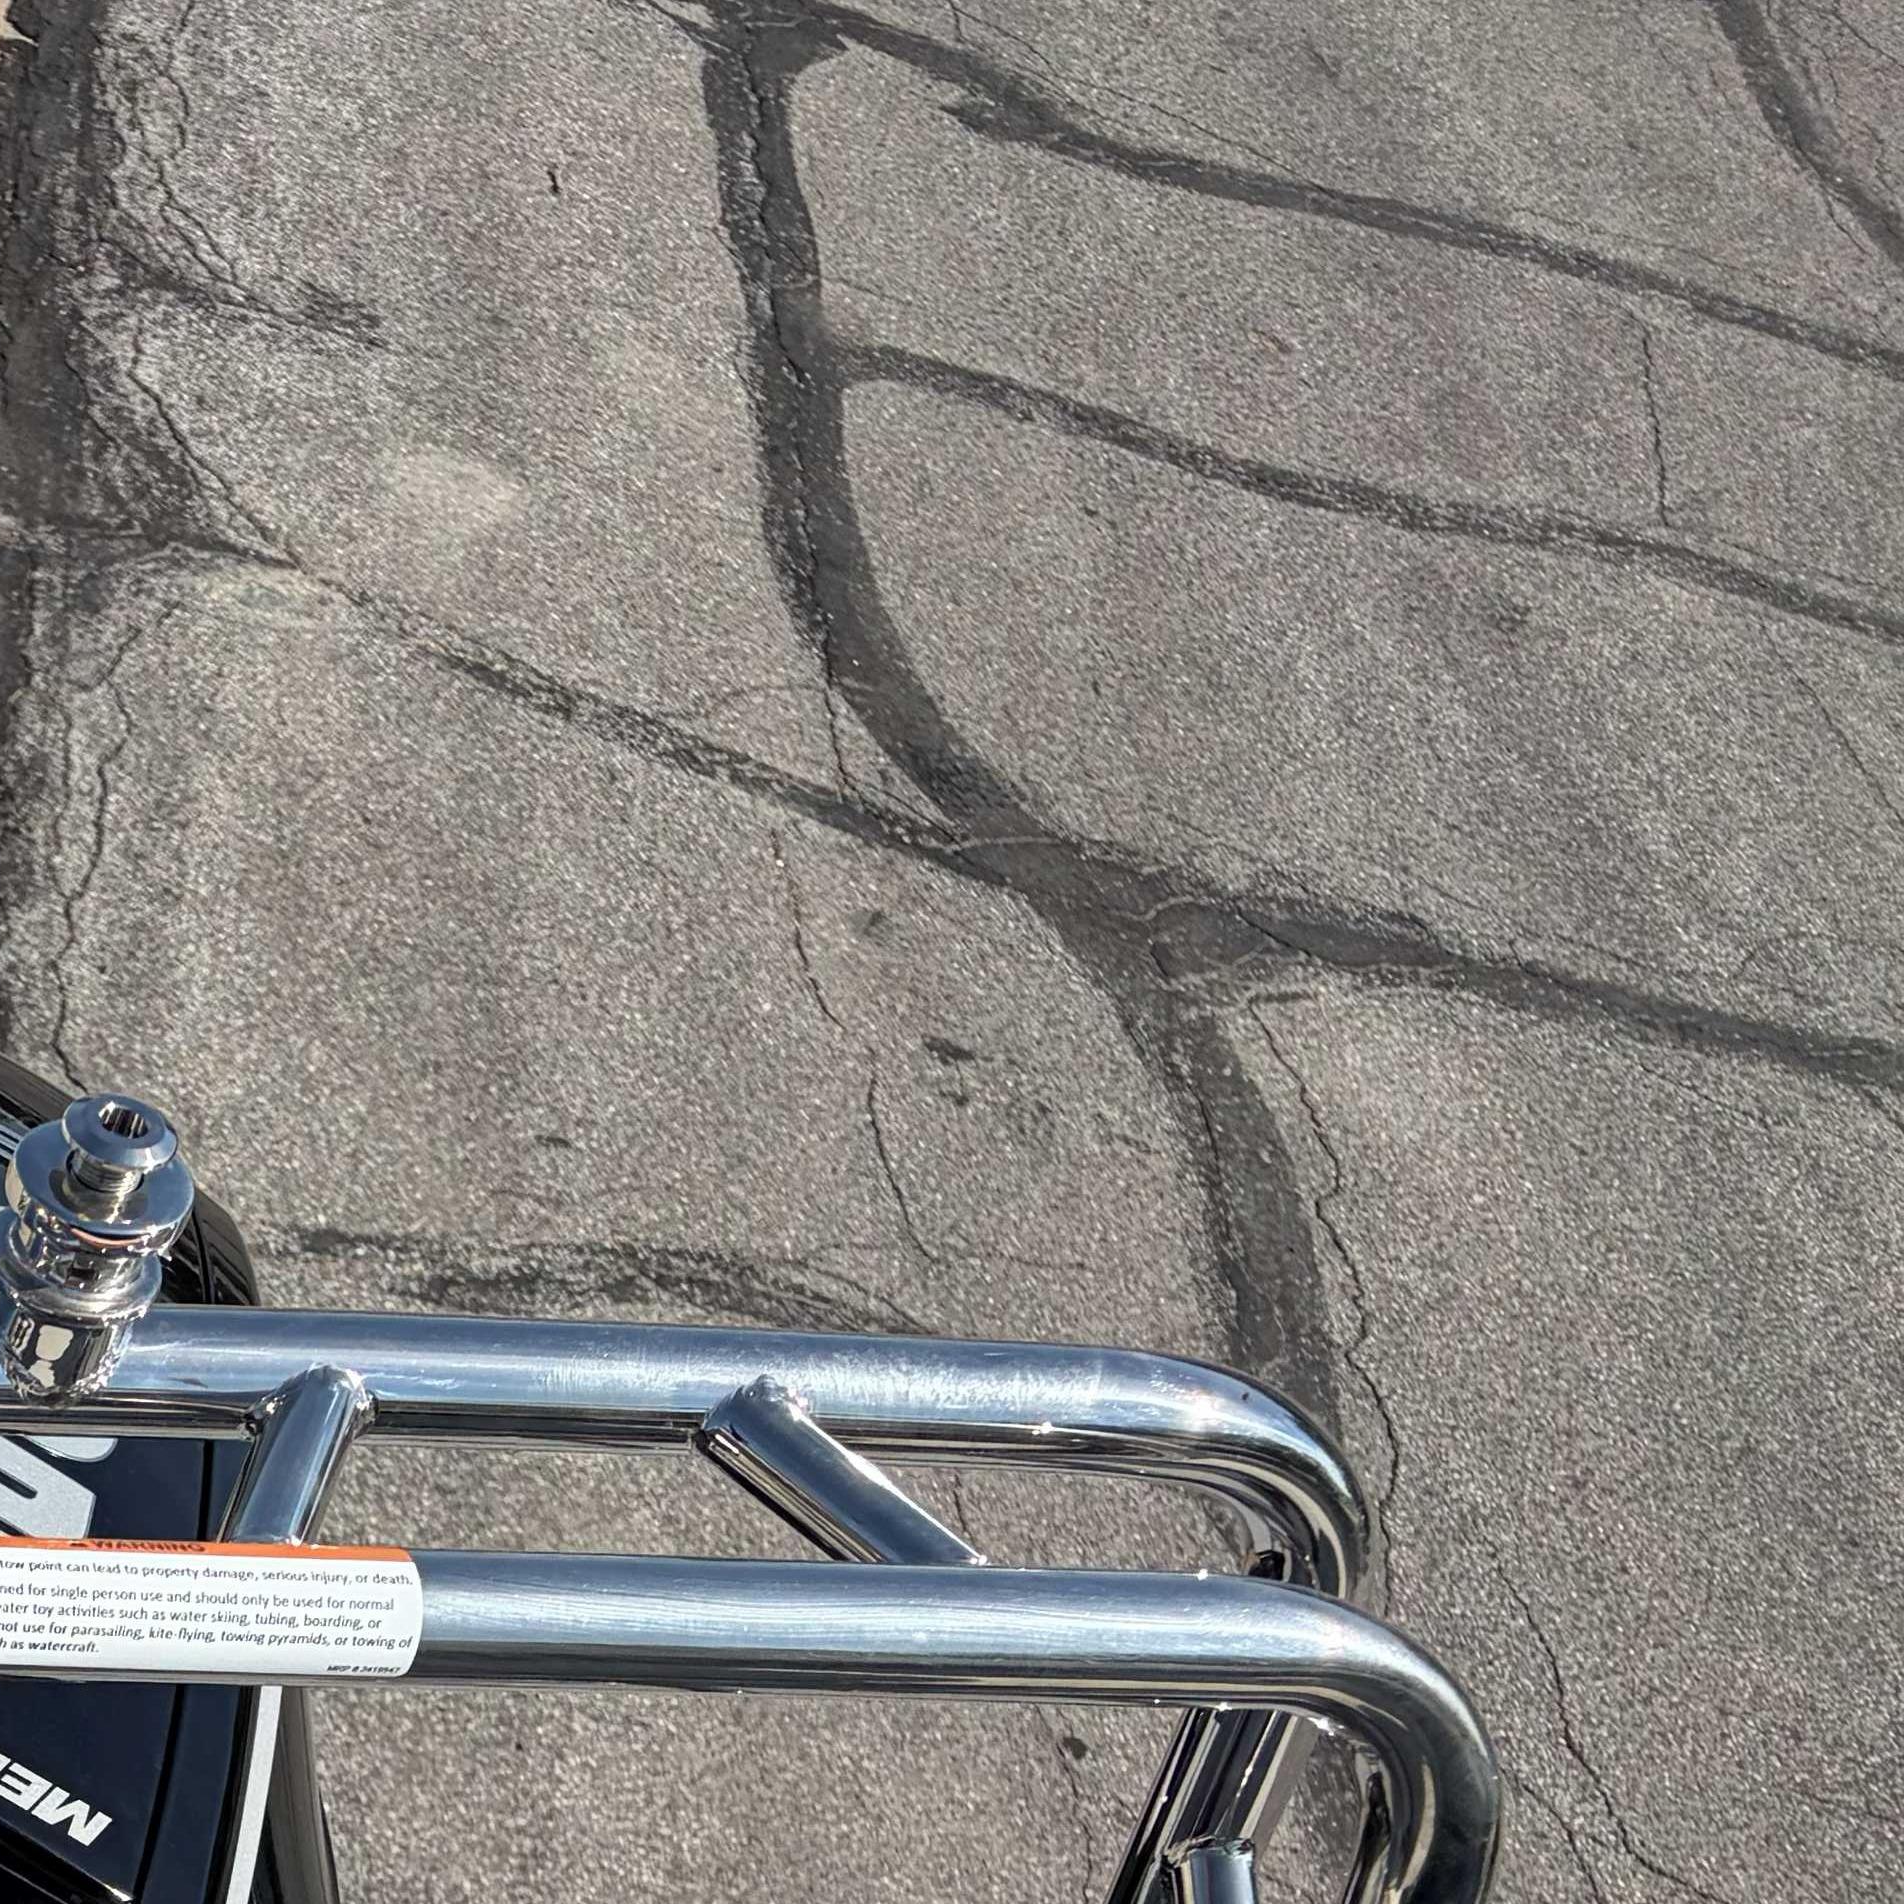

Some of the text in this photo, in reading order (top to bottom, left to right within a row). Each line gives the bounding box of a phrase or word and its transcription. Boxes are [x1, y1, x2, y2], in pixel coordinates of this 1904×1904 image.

[0, 1560, 24, 1569] tow
[29, 1561, 63, 1572] point
[66, 1564, 90, 1572] can
[93, 1562, 120, 1574] lead
[124, 1564, 138, 1574] to
[142, 1567, 198, 1580] property
[202, 1568, 258, 1581] damage,
[262, 1570, 308, 1582] serious
[311, 1571, 353, 1586] injury,
[355, 1575, 369, 1583] or
[373, 1573, 413, 1585] death.
[28, 1584, 47, 1596] for
[51, 1586, 87, 1600] single
[92, 1588, 136, 1601] person
[141, 1592, 163, 1601] use
[167, 1591, 191, 1602] and
[195, 1592, 237, 1605] should
[242, 1594, 270, 1609] only
[273, 1594, 289, 1607] be
[293, 1596, 323, 1608] used
[327, 1597, 345, 1609] for
[349, 1598, 394, 1610] normal
[33, 1604, 54, 1617] toy
[57, 1605, 115, 1618] activities
[120, 1606, 148, 1620] such
[152, 1610, 166, 1621] as
[170, 1610, 208, 1622] water
[211, 1610, 251, 1626] skiing,
[255, 1613, 299, 1628] tubing,
[304, 1614, 363, 1631] boarding,
[368, 1618, 382, 1628] or
[11, 1640, 24, 1649] as
[28, 1642, 99, 1652] watercraft.
[23, 1624, 45, 1633] use
[49, 1622, 68, 1635] for
[71, 1625, 144, 1640] parasailing,
[149, 1627, 216, 1643] kite-flying,
[221, 1631, 265, 1645] towing
[267, 1633, 331, 1646] pyramids,
[335, 1637, 348, 1645] or
[352, 1636, 396, 1649] towing
[399, 1636, 413, 1648] of
